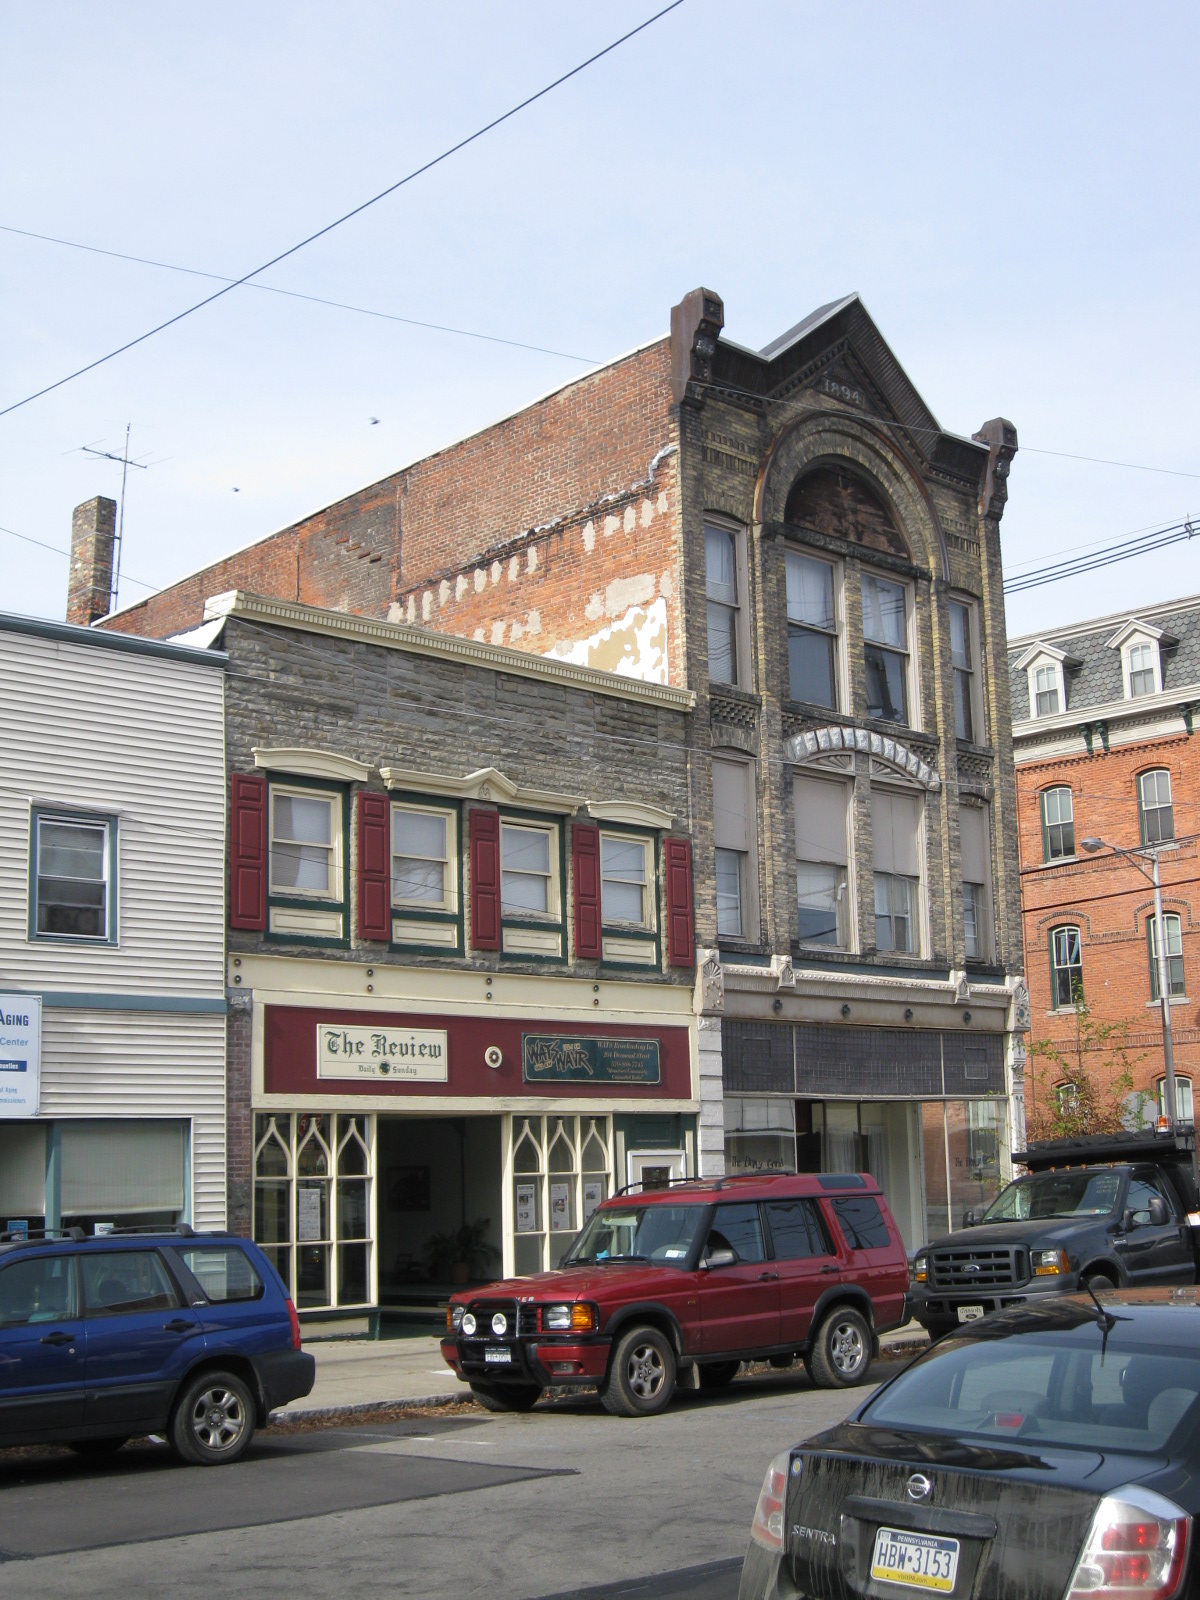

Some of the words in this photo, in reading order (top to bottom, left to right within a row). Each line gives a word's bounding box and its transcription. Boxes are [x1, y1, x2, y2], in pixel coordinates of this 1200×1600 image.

[824, 379, 860, 404] 1894
[0, 1037, 28, 1047] Center
[324, 1031, 365, 1059] The
[371, 1033, 442, 1059] Review
[358, 1064, 376, 1075] Daily
[392, 1065, 418, 1076] Sunday
[791, 1524, 836, 1546] SENTRA
[897, 1535, 938, 1548] PENNSYLVANIA
